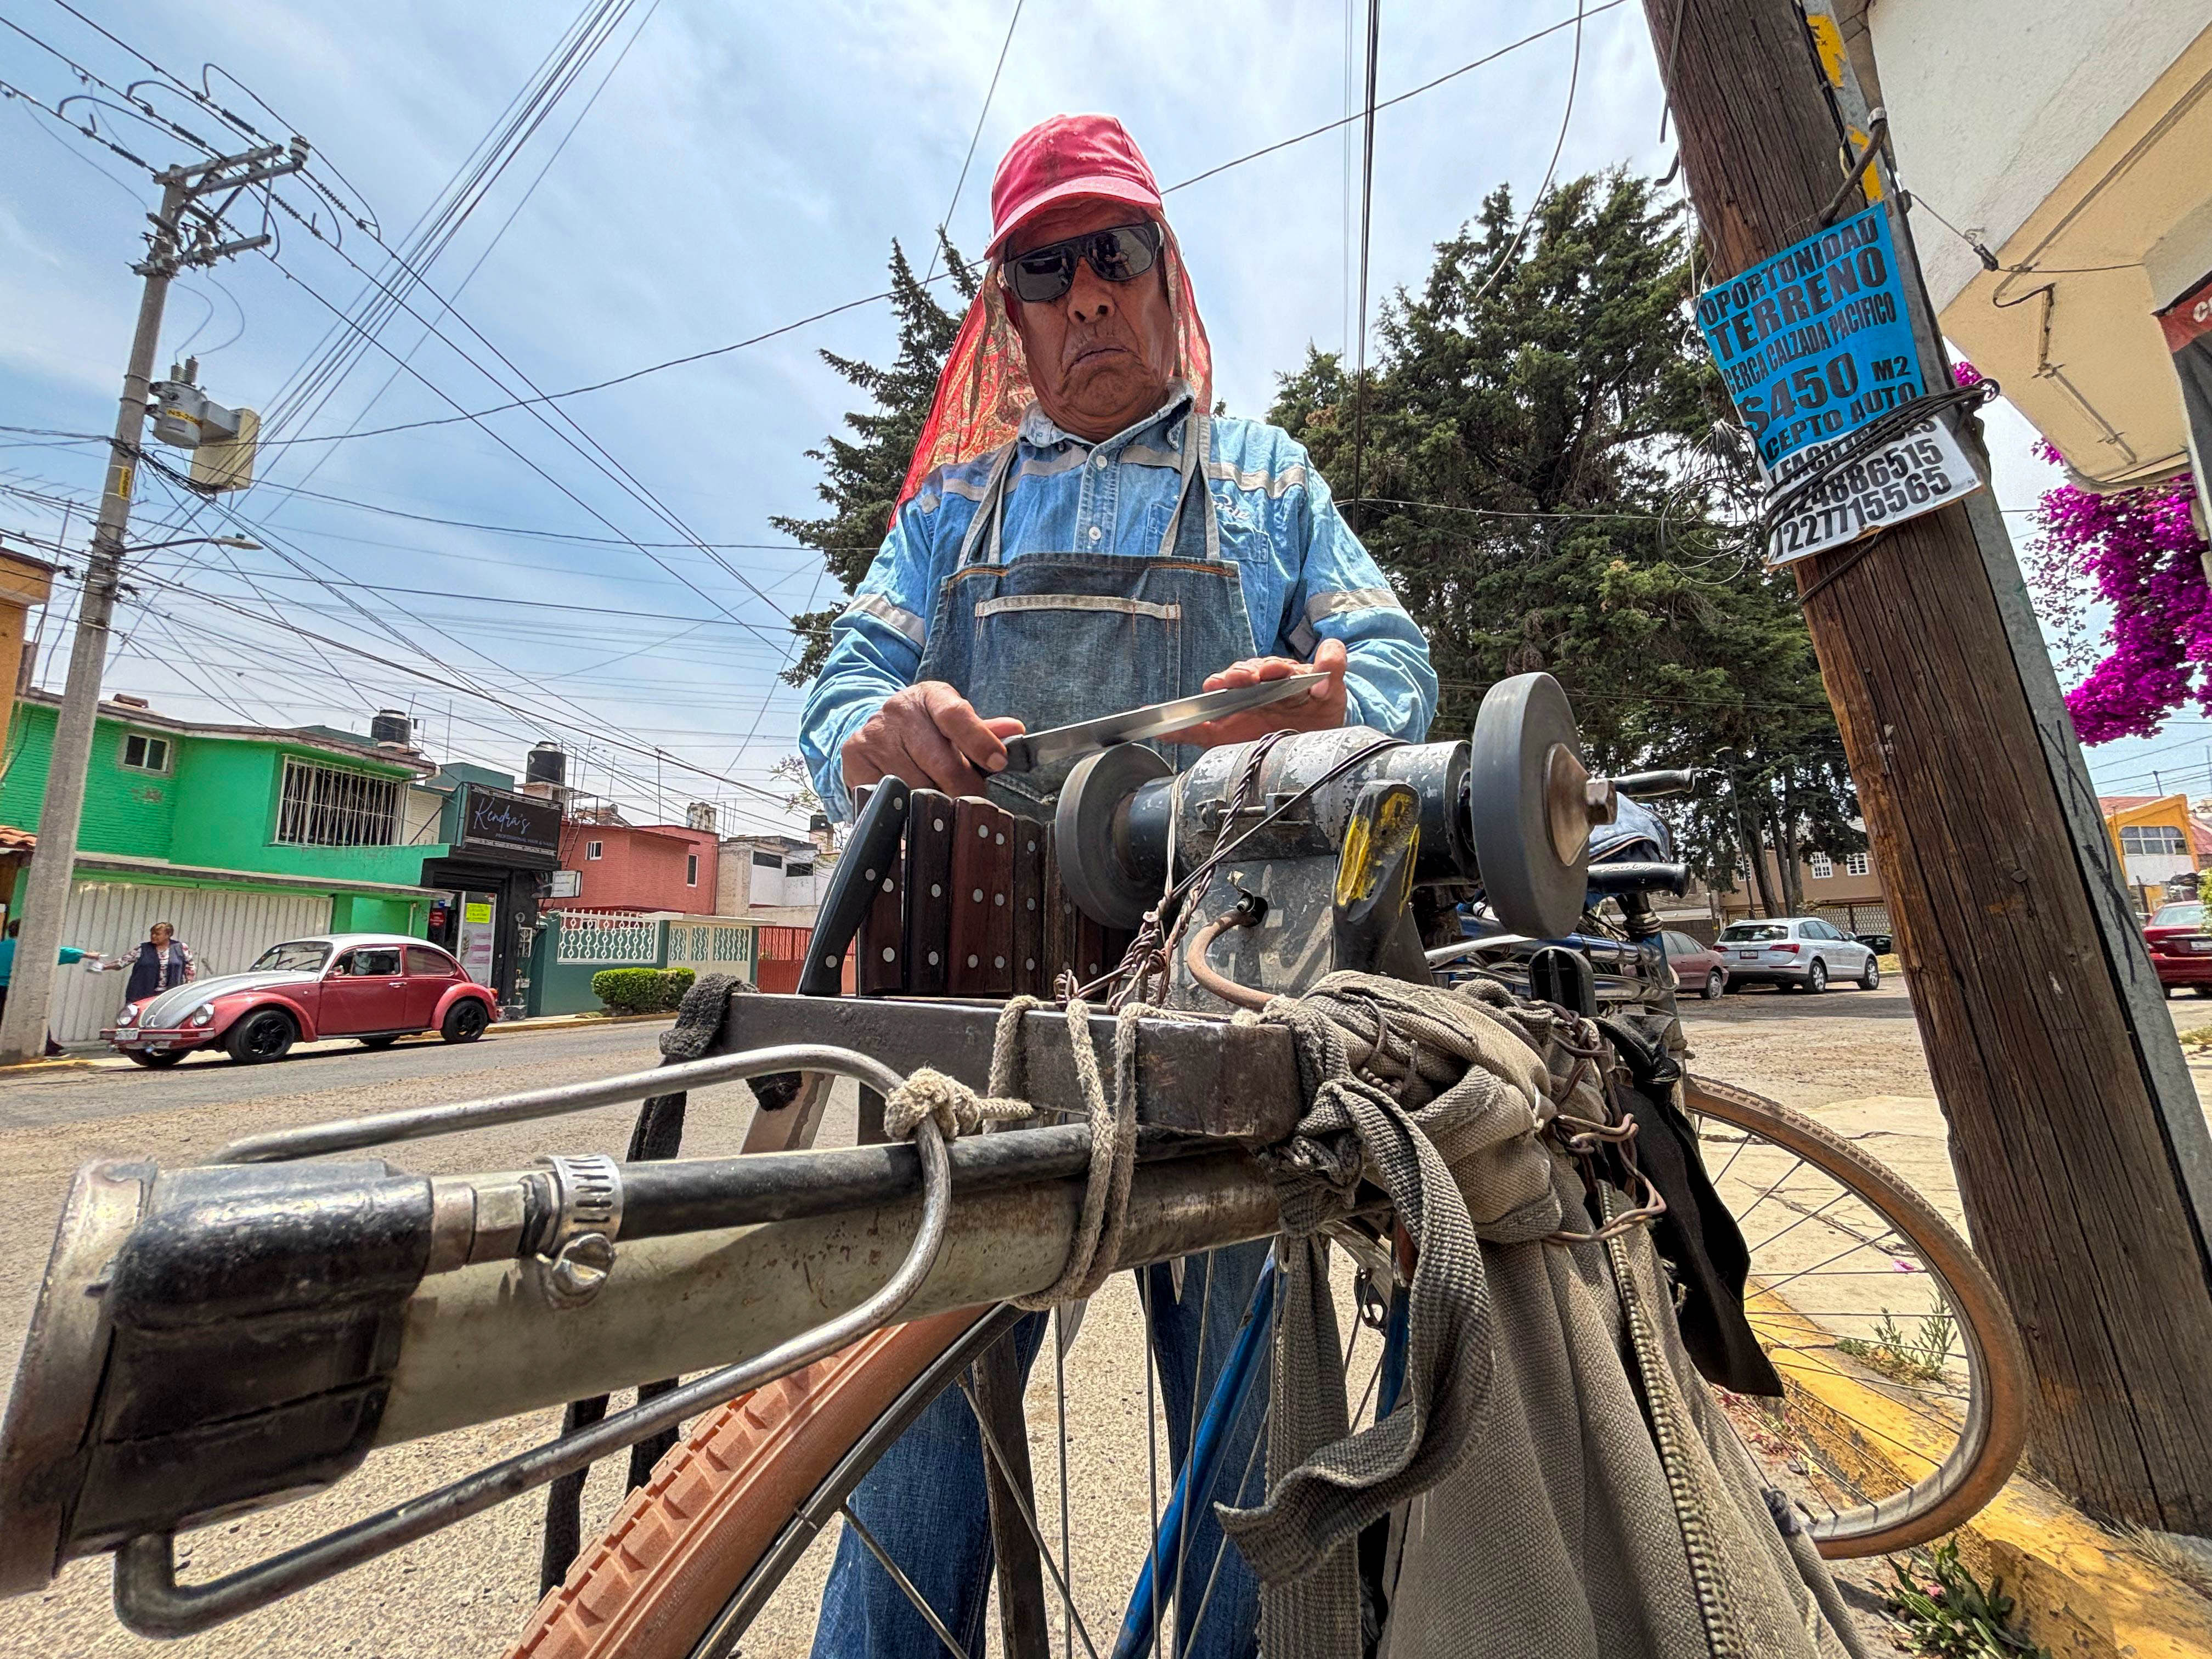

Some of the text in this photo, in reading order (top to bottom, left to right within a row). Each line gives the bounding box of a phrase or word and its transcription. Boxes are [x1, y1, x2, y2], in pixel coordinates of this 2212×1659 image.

[1701, 216, 1878, 326] OPORTUNIDAD
[1708, 247, 1888, 361] TERRENO
[1723, 292, 1897, 396] CERCA CALZADA PACIFICO
[1737, 352, 1911, 439] $450 M2
[1850, 382, 1917, 424] AUTO
[1775, 438, 1944, 520] 24886515
[473, 797, 531, 834] Kendra's
